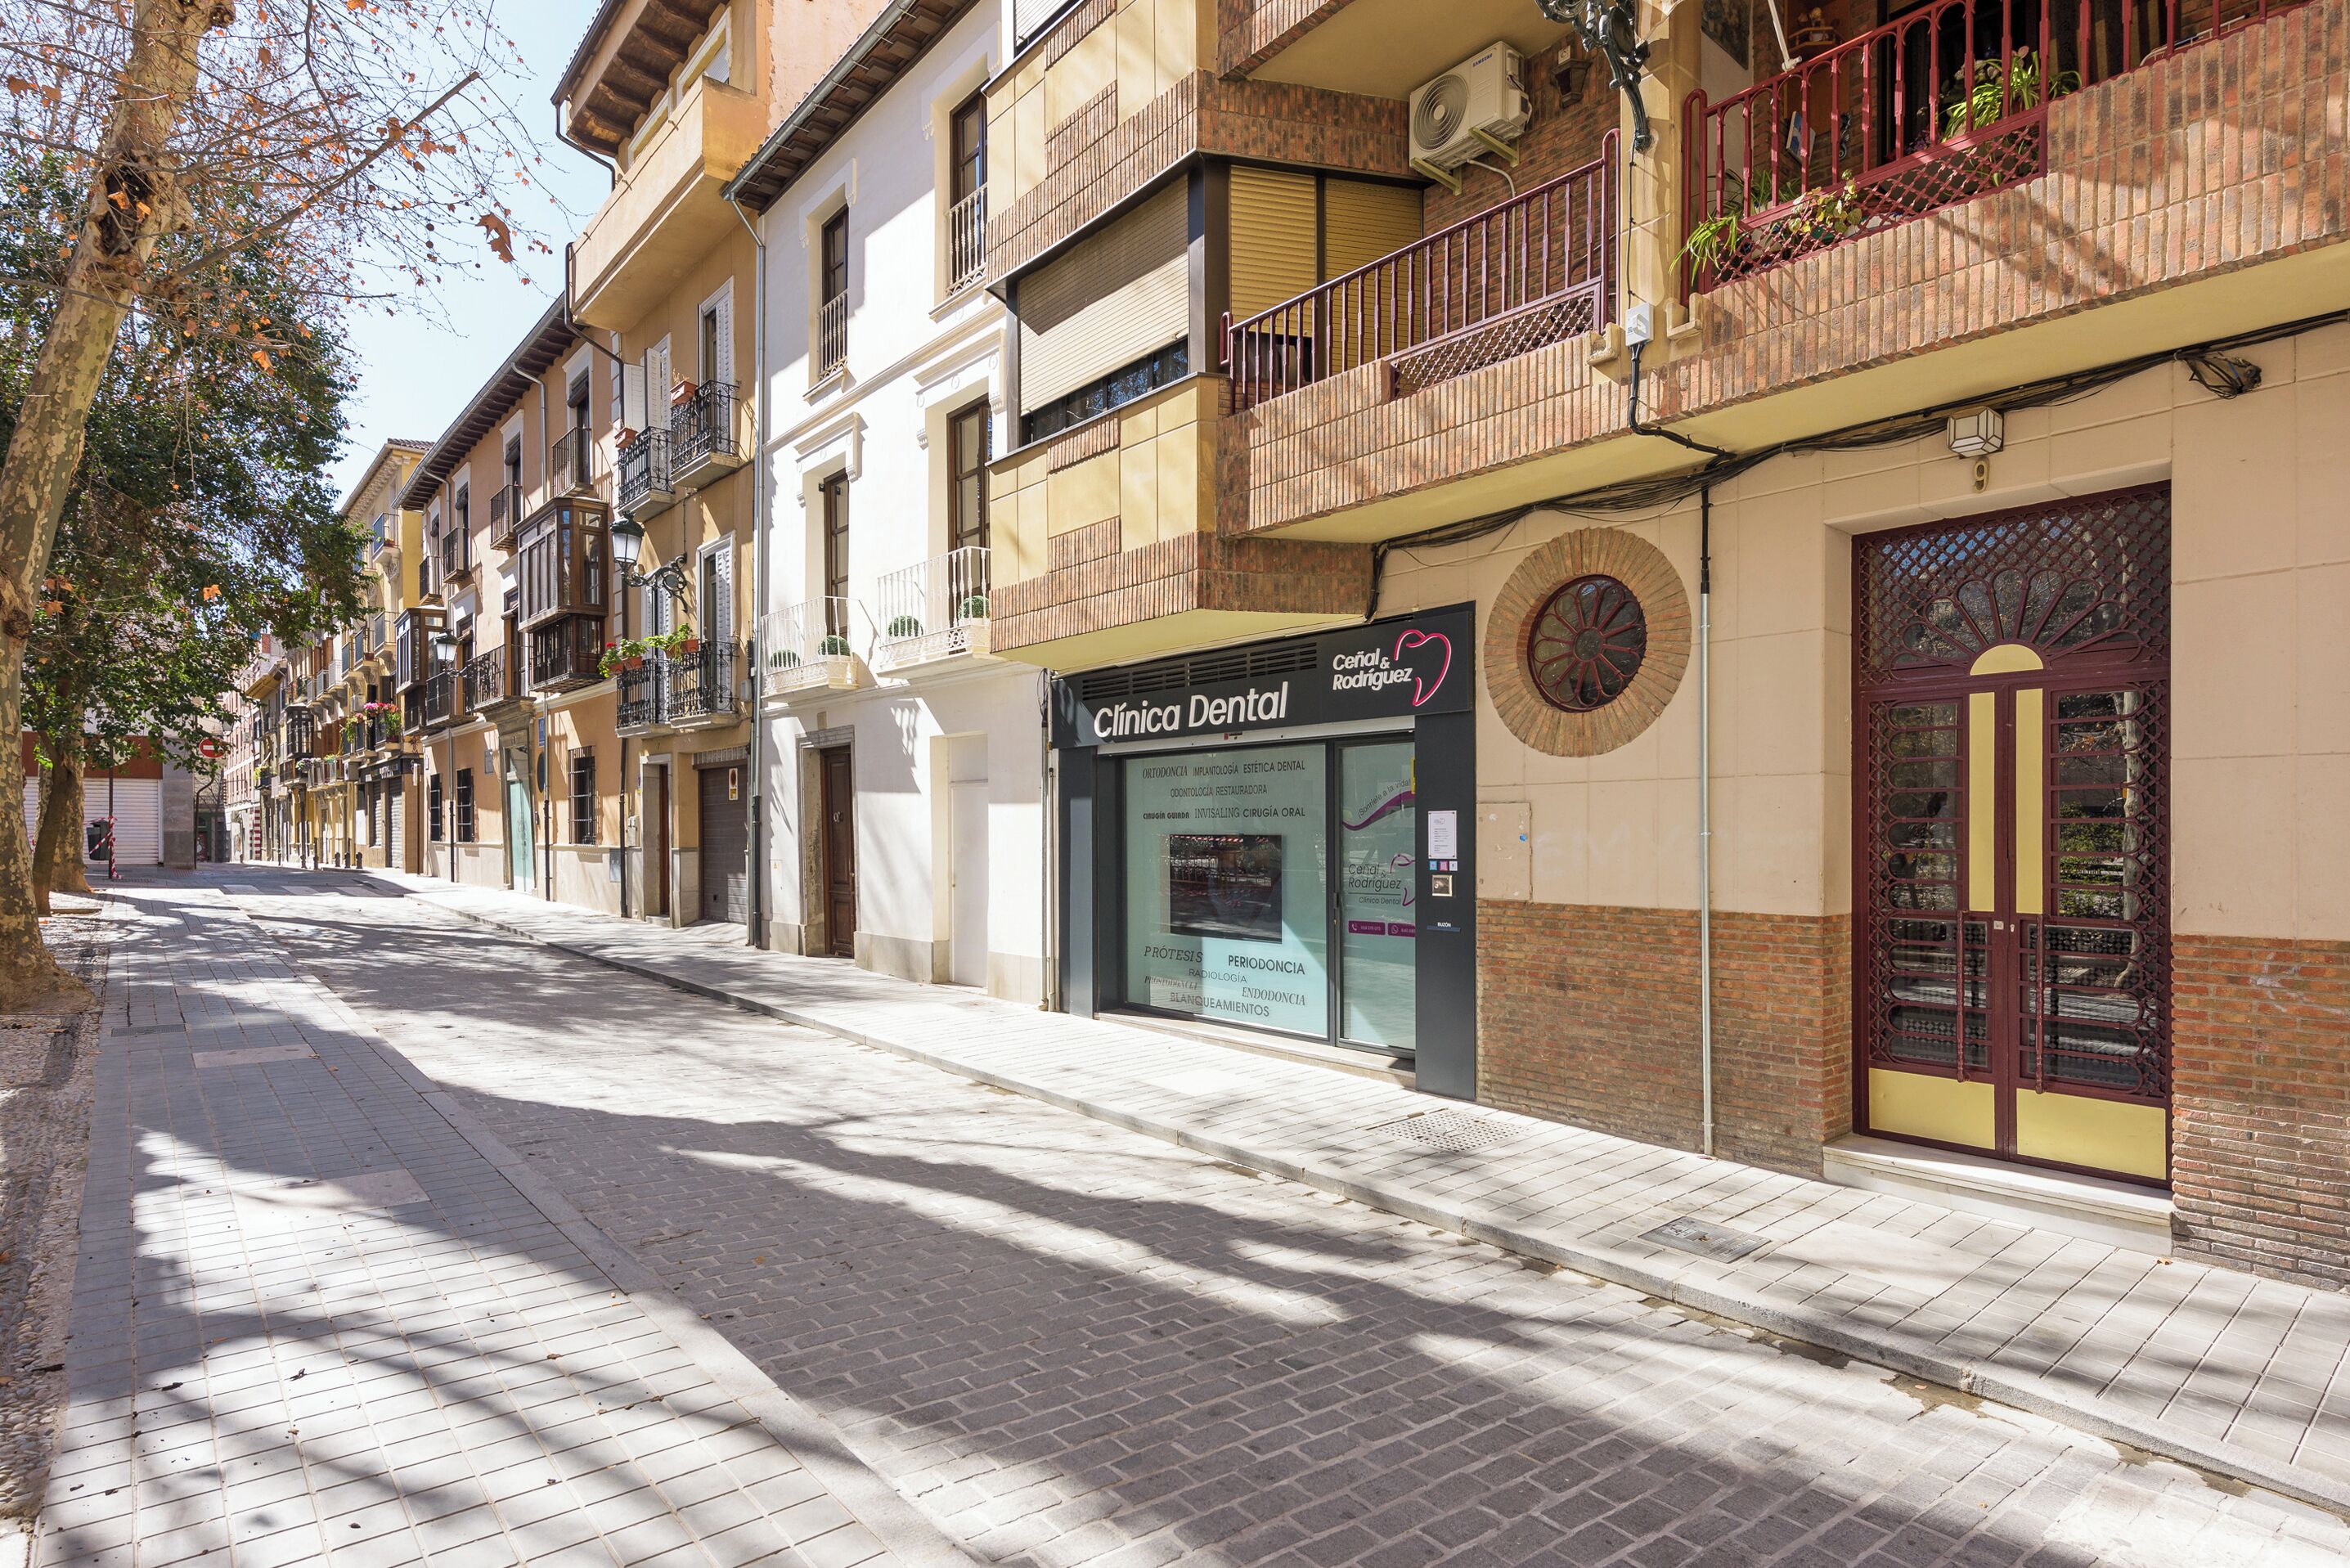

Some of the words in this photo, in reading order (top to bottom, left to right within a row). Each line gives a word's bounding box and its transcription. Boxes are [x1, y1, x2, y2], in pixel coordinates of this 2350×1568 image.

[1972, 461, 1988, 494] 9
[1332, 648, 1381, 671] Ceñal
[1380, 656, 1390, 669] &
[1332, 667, 1413, 691] Rodríguez
[1094, 700, 1181, 738] Clínica
[1188, 681, 1288, 727] Dental
[1143, 766, 1188, 779] ORTODONCIA
[1193, 762, 1238, 776] IMPLANTOLOGÍA
[1243, 761, 1275, 774] ESTÉTICA
[1277, 760, 1305, 771] DENTAL
[1171, 785, 1213, 797] ODONTOLOGÍA
[1215, 784, 1267, 796] RESTAURADORA
[1243, 805, 1278, 818] CIRUGÍA
[1281, 806, 1305, 817] ORAL
[1348, 863, 1380, 874] Ceñal
[1348, 877, 1401, 892] Rodríguez
[1380, 896, 1401, 905] Dental
[1144, 945, 1203, 963] PRÓTESIS
[1229, 955, 1305, 975] PERIODONCIA
[1188, 968, 1247, 983] RADIOLOGÍA
[1170, 992, 1269, 1017] BLANQUEAMIENTOS
[1242, 986, 1305, 1005] ENDODONCIA
